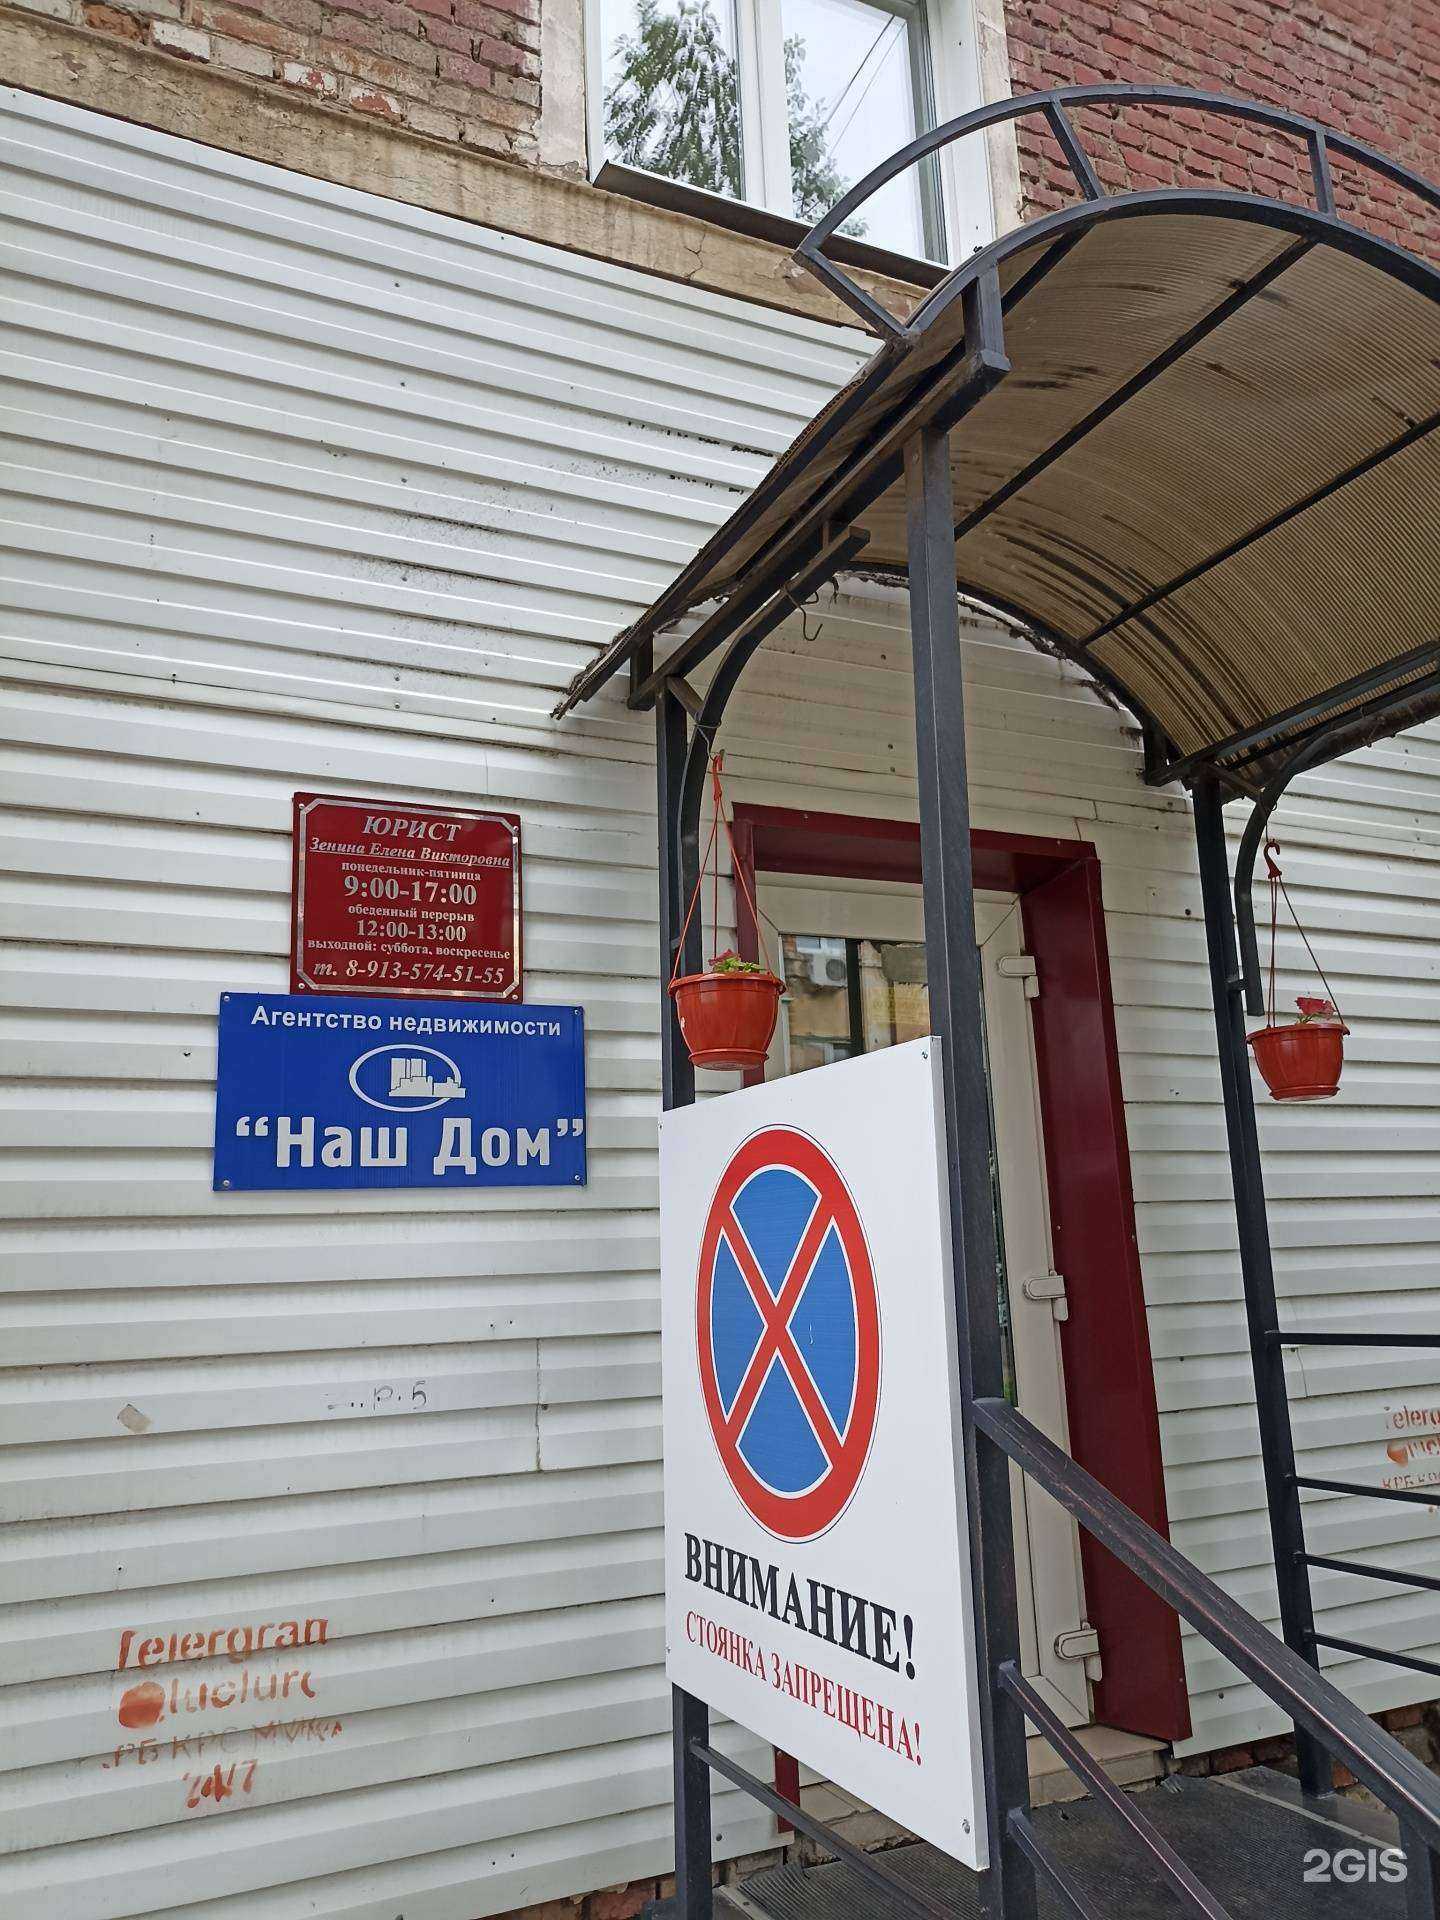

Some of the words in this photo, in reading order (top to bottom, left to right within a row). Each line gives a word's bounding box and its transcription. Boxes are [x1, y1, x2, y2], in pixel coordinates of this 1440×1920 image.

[362, 815, 461, 842] ЮРИСТ
[309, 837, 365, 855] Зенина
[369, 842, 416, 860] Елена
[420, 848, 510, 867] Викторовна
[341, 861, 481, 882] понедельник-пятница
[344, 875, 477, 905] 9:00-17:00
[348, 903, 418, 919] обеденный
[421, 911, 475, 923] перерыв
[357, 919, 467, 942] 12:00-13:00
[308, 938, 377, 952] выходной:
[436, 946, 511, 960] воскресенье
[346, 959, 505, 984] 8-913-574-51-55
[251, 1005, 382, 1031] Агентство
[389, 1015, 561, 1036] недвижимости
[684, 1532, 916, 1681] ВНИМАНИЕ!
[685, 1610, 768, 1682] СТОЯНКА
[771, 1652, 922, 1766] ЗАПРЕЩЕНА!
